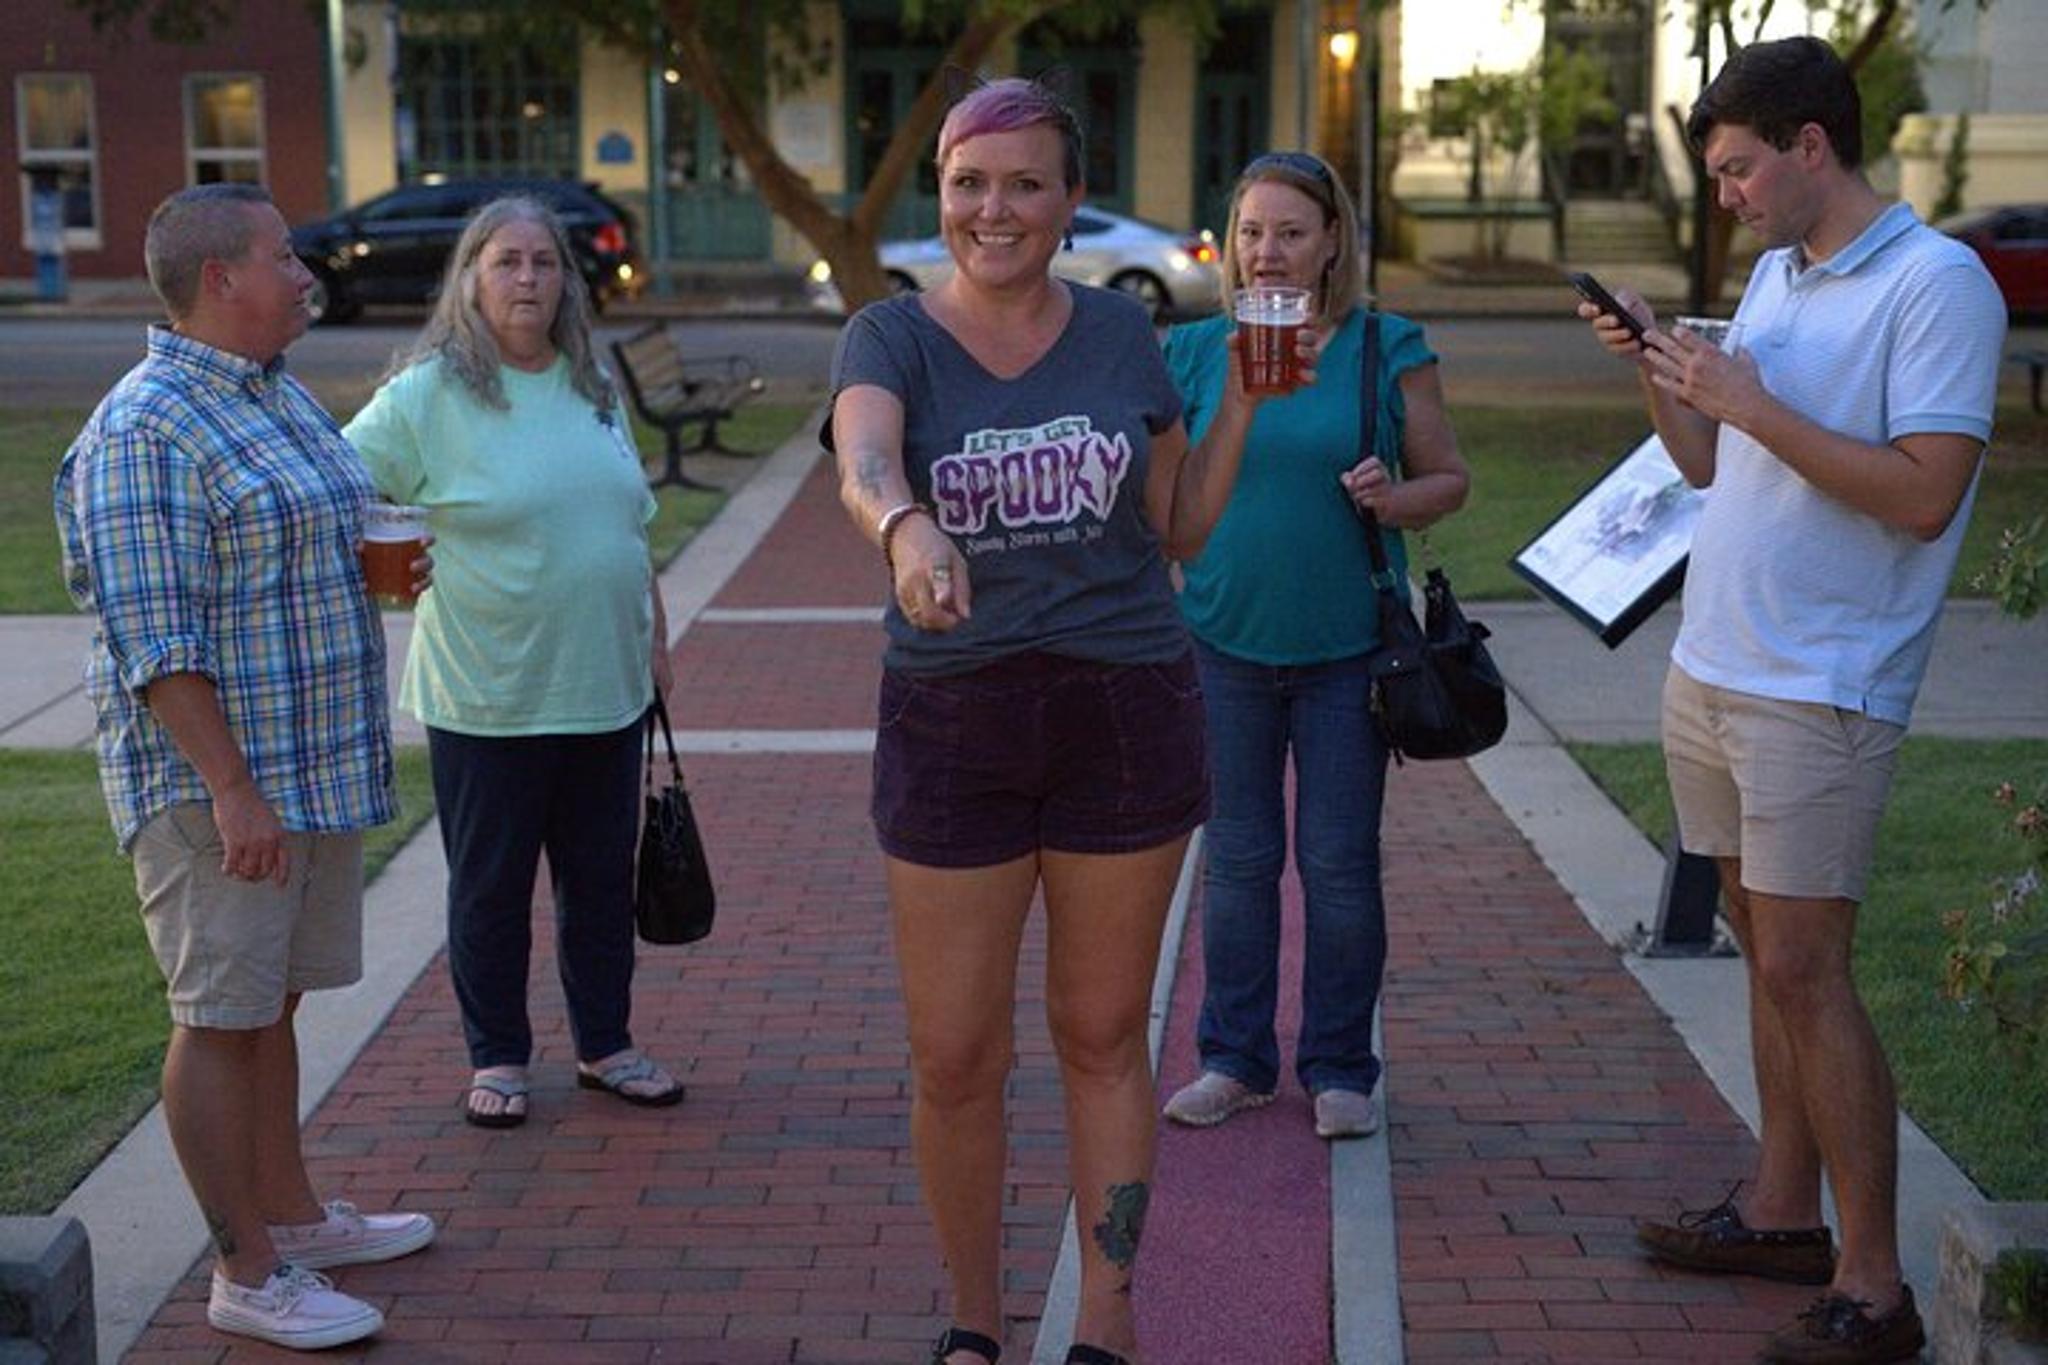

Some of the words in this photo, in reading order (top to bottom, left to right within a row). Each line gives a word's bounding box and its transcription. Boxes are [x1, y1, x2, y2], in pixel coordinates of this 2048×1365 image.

[968, 430, 1033, 454] LET'S
[1044, 420, 1088, 441] GET
[933, 434, 1129, 530] SPOOKY
